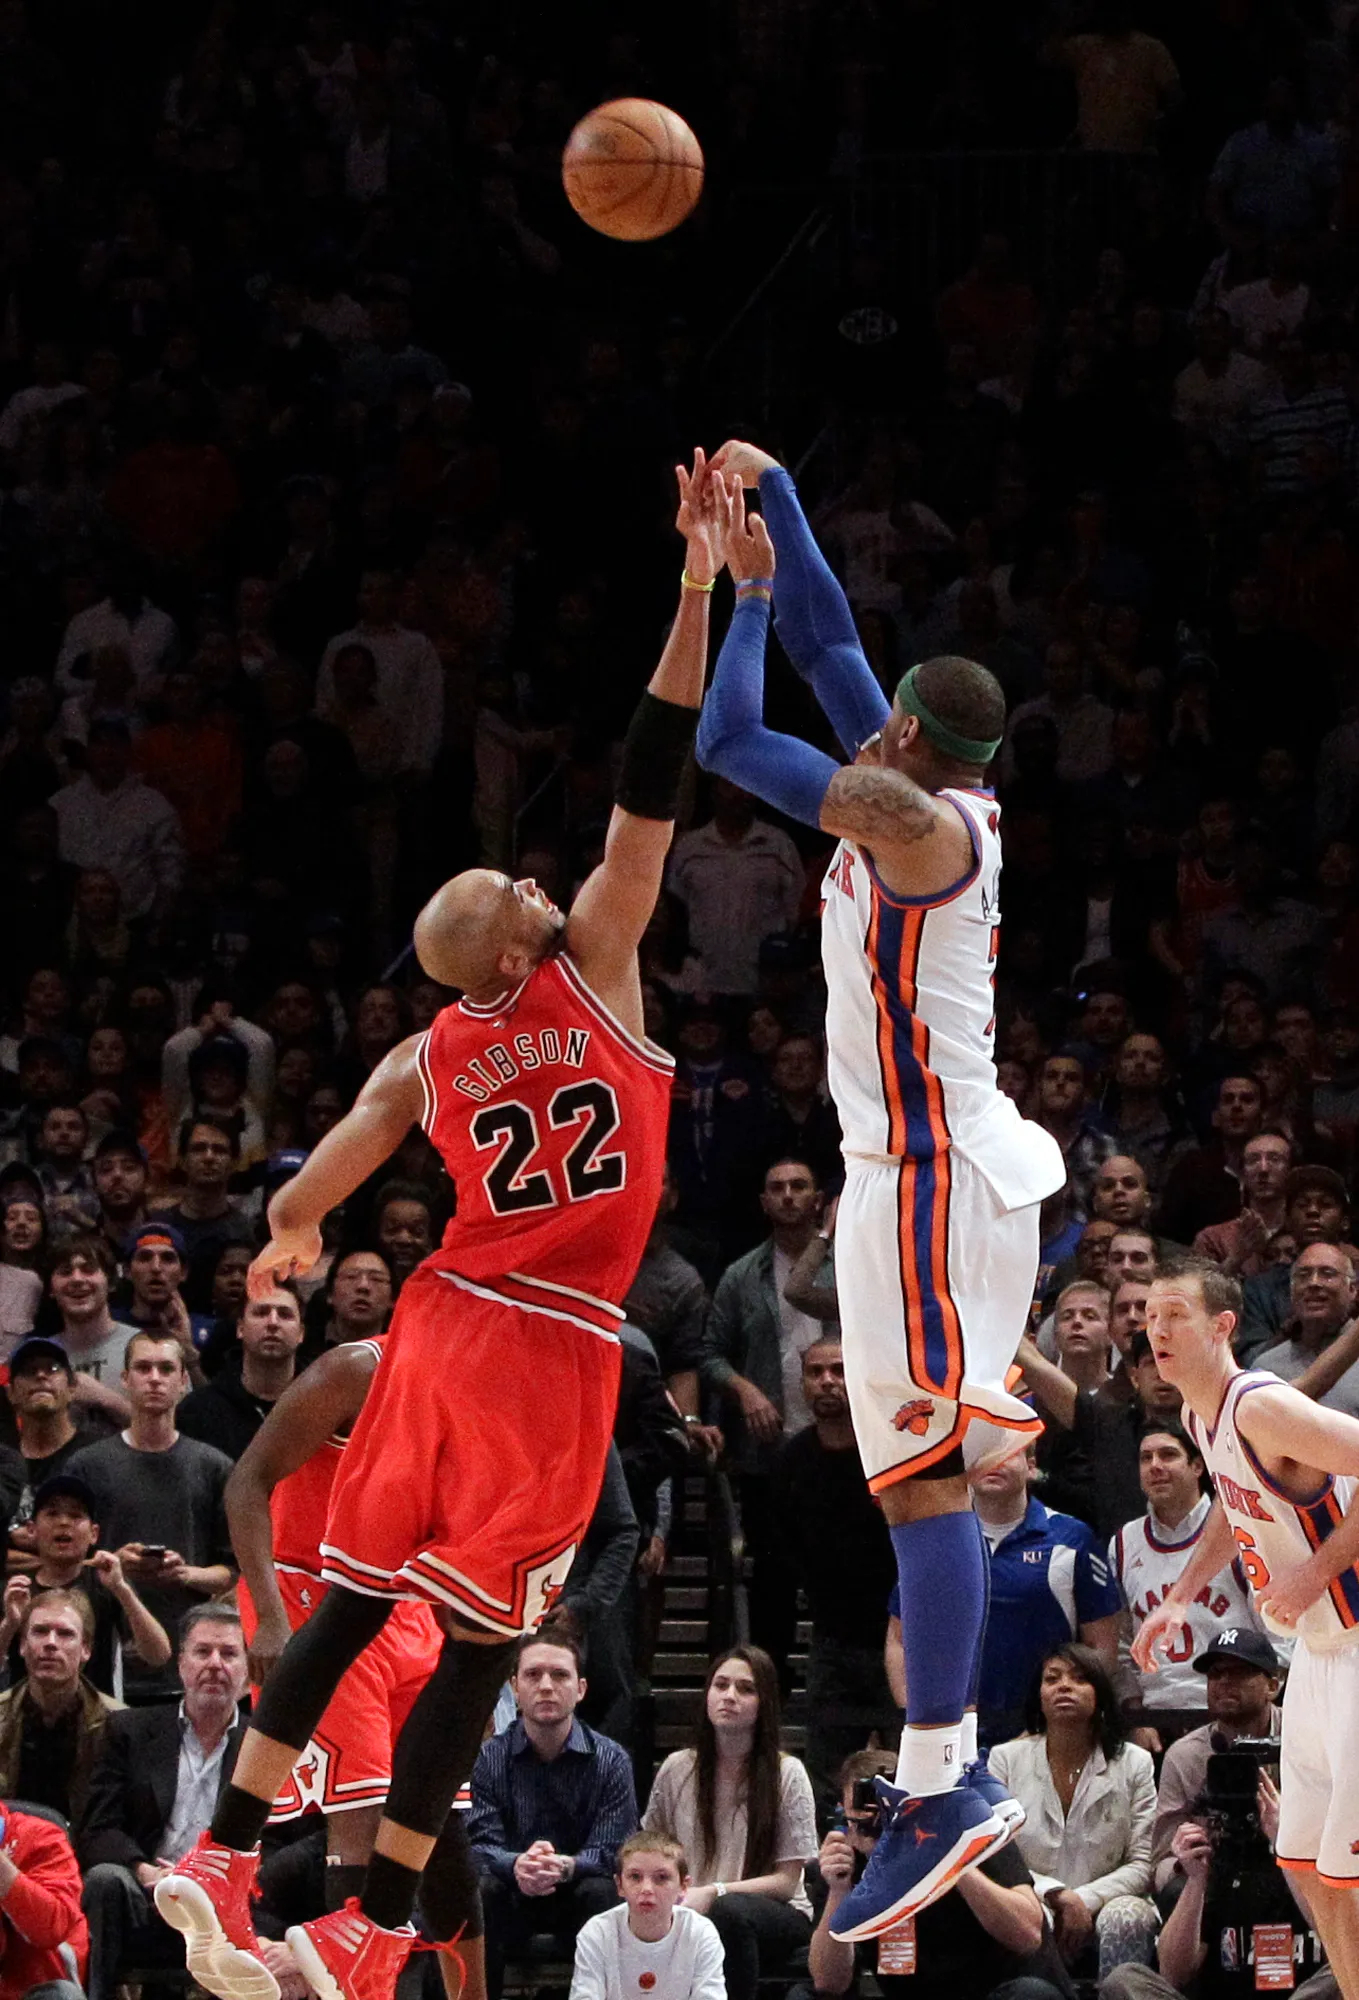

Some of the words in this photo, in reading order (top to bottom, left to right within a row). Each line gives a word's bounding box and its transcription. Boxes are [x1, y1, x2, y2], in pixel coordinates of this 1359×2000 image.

[453, 1028, 590, 1102] GIBSON
[469, 1077, 628, 1217] 22
[1023, 1551, 1042, 1564] KU
[1218, 1629, 1239, 1645] NY
